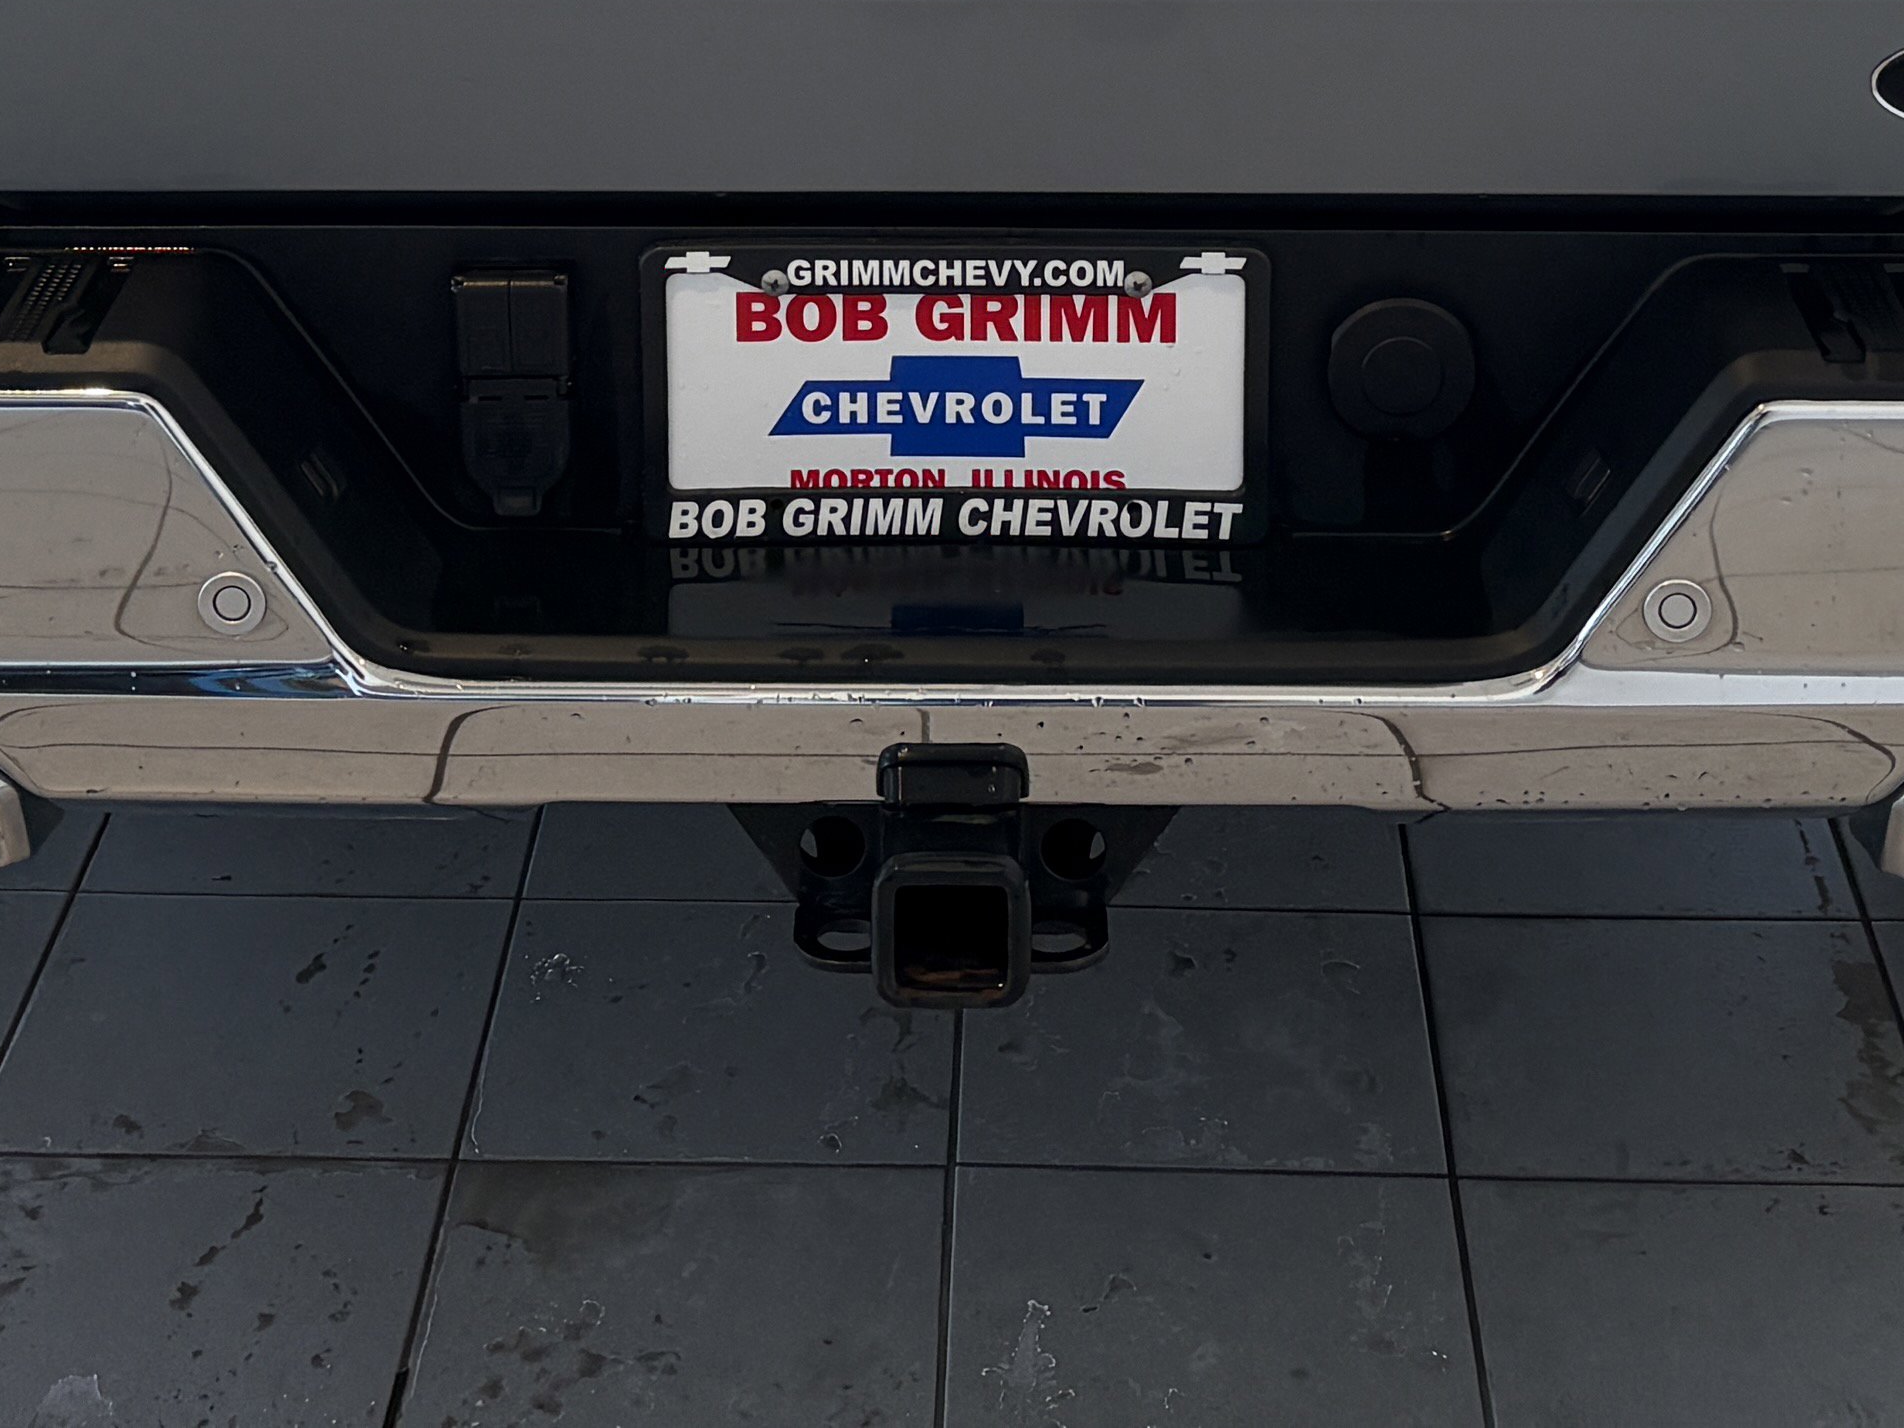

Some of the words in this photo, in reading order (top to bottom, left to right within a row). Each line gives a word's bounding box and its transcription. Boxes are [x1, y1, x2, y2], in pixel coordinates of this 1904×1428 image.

[786, 259, 1125, 288] GRIMMCHEVY.COM
[735, 291, 889, 343] BOB
[914, 292, 1178, 344] GRIMM
[801, 391, 1108, 426] CHEVROLET
[790, 468, 946, 489] MORTON
[668, 500, 767, 539] BOB
[781, 497, 944, 537] GRIMM
[957, 498, 1244, 541] CHEVROLET
